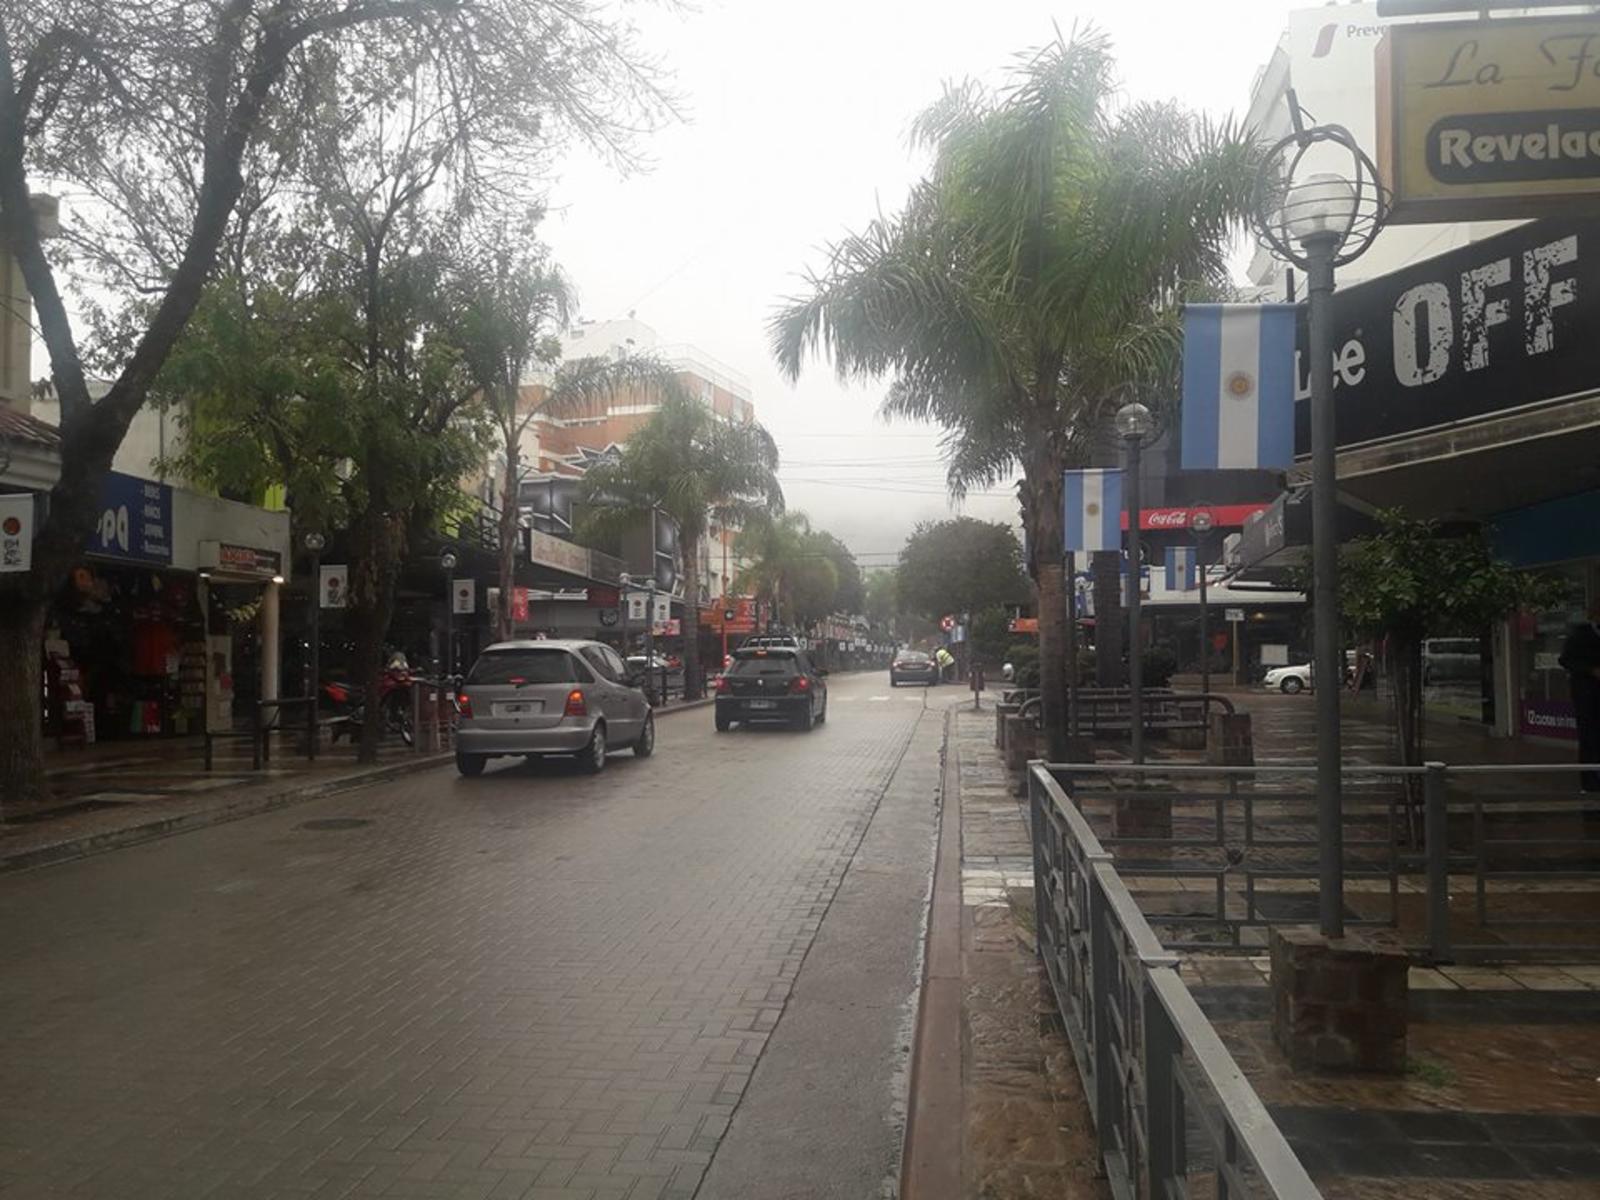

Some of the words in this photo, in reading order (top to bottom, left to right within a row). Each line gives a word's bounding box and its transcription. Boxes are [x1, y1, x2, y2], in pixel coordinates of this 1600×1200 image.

[1422, 39, 1503, 89] La
[1294, 338, 1367, 401] Le
[1392, 235, 1578, 388] OFF
